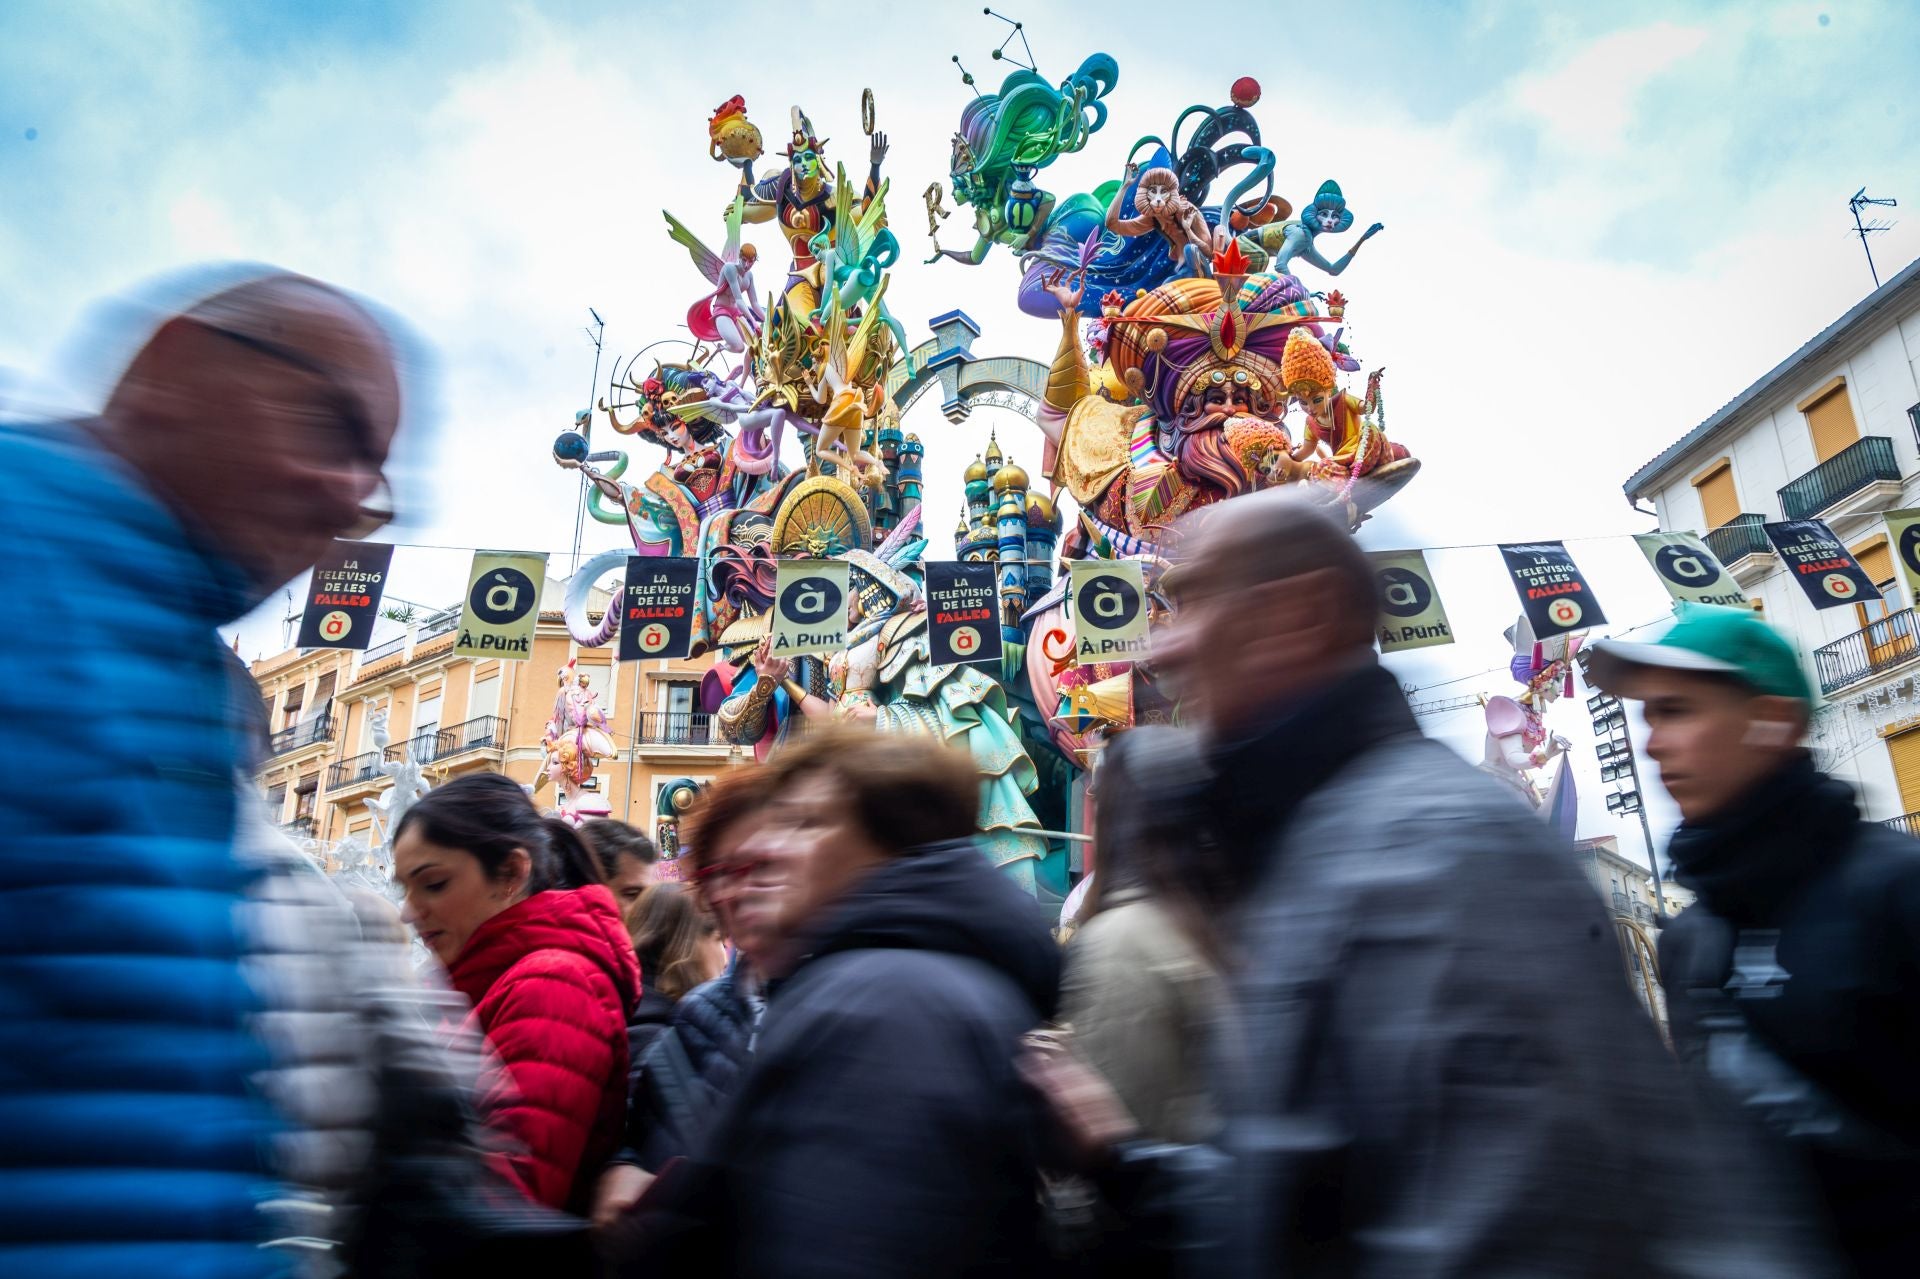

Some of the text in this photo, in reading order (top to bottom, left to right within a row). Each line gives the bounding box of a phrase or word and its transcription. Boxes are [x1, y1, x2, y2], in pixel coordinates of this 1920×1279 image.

[1797, 534, 1814, 544] LA
[1781, 539, 1840, 556] TELEVISIÓ
[1533, 556, 1549, 566] LA
[1797, 549, 1839, 563] DE LES
[343, 560, 358, 570] LA
[1515, 563, 1576, 578] TELEVISIÓ
[1797, 558, 1851, 575] FALLES
[317, 571, 382, 584] TELEVISIÓ
[653, 574, 668, 583] LA
[954, 578, 969, 587] LA
[1529, 573, 1570, 587] DE LES
[324, 583, 366, 593] DE LES
[628, 584, 691, 596] TELEVISIÓ
[930, 586, 993, 600] TELEVISIÓ
[1527, 582, 1582, 600] FALLES
[314, 593, 371, 607] FALLES
[637, 595, 679, 606] DE LES
[942, 598, 983, 609] DE LES
[629, 606, 685, 619] FALLES
[936, 608, 991, 624] FALLES
[1381, 622, 1449, 644] À Punt
[457, 629, 529, 652] À Punt
[775, 632, 843, 650] À Punt
[1080, 636, 1147, 655] À Punt
